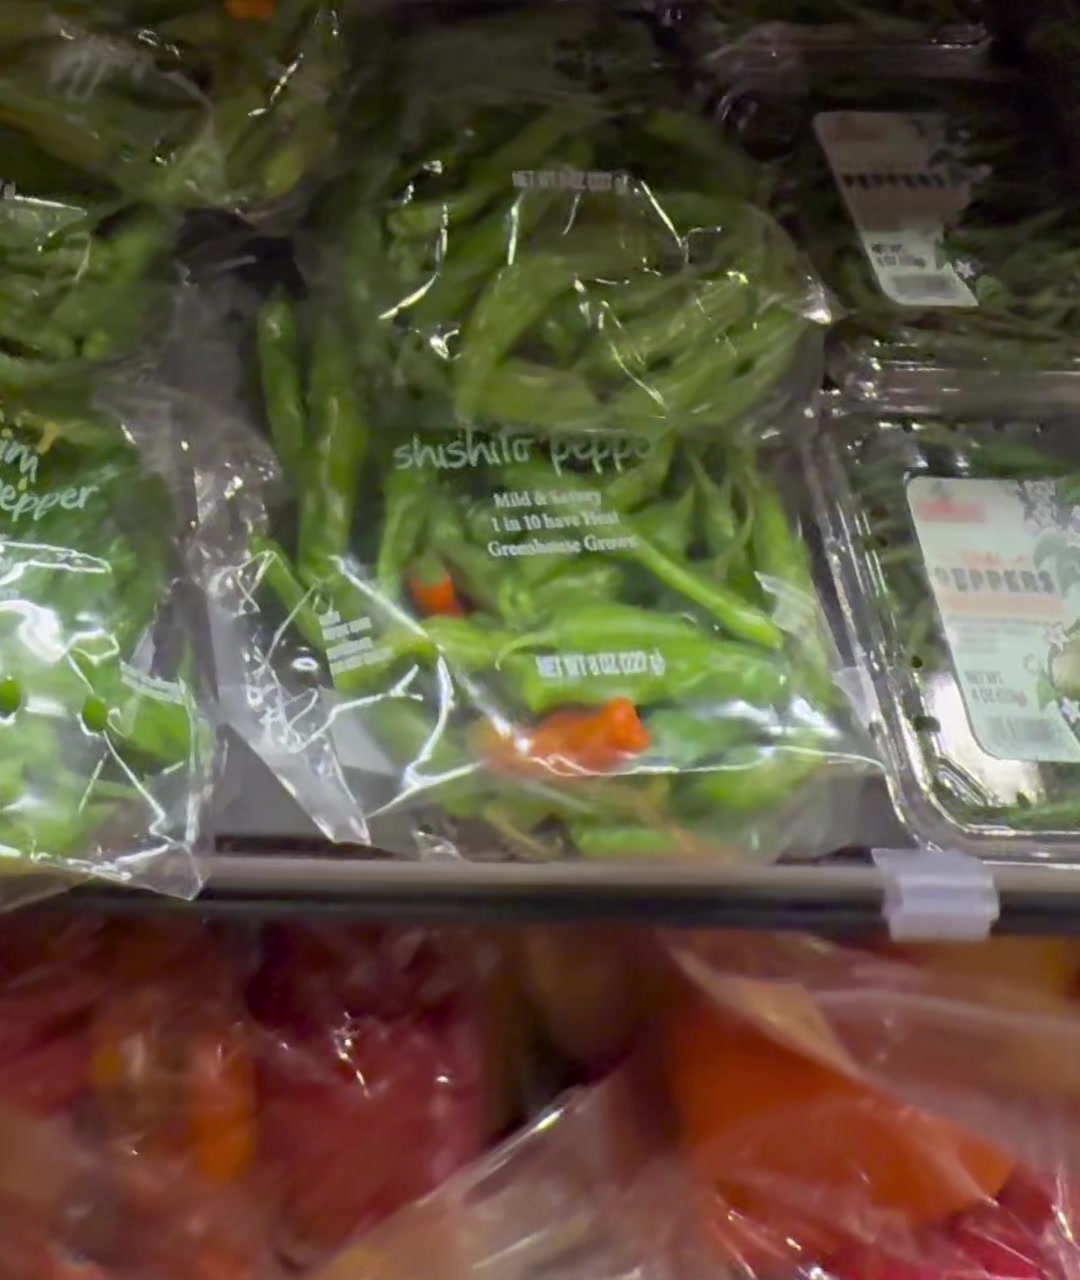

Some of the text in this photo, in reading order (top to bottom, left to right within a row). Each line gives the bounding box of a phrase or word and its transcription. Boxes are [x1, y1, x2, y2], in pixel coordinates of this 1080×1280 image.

[493, 490, 532, 508] Mild
[491, 517, 501, 532] 1
[504, 515, 521, 532] in
[523, 513, 542, 531] 10
[543, 512, 581, 529] have
[487, 538, 582, 557] Greenhouse
